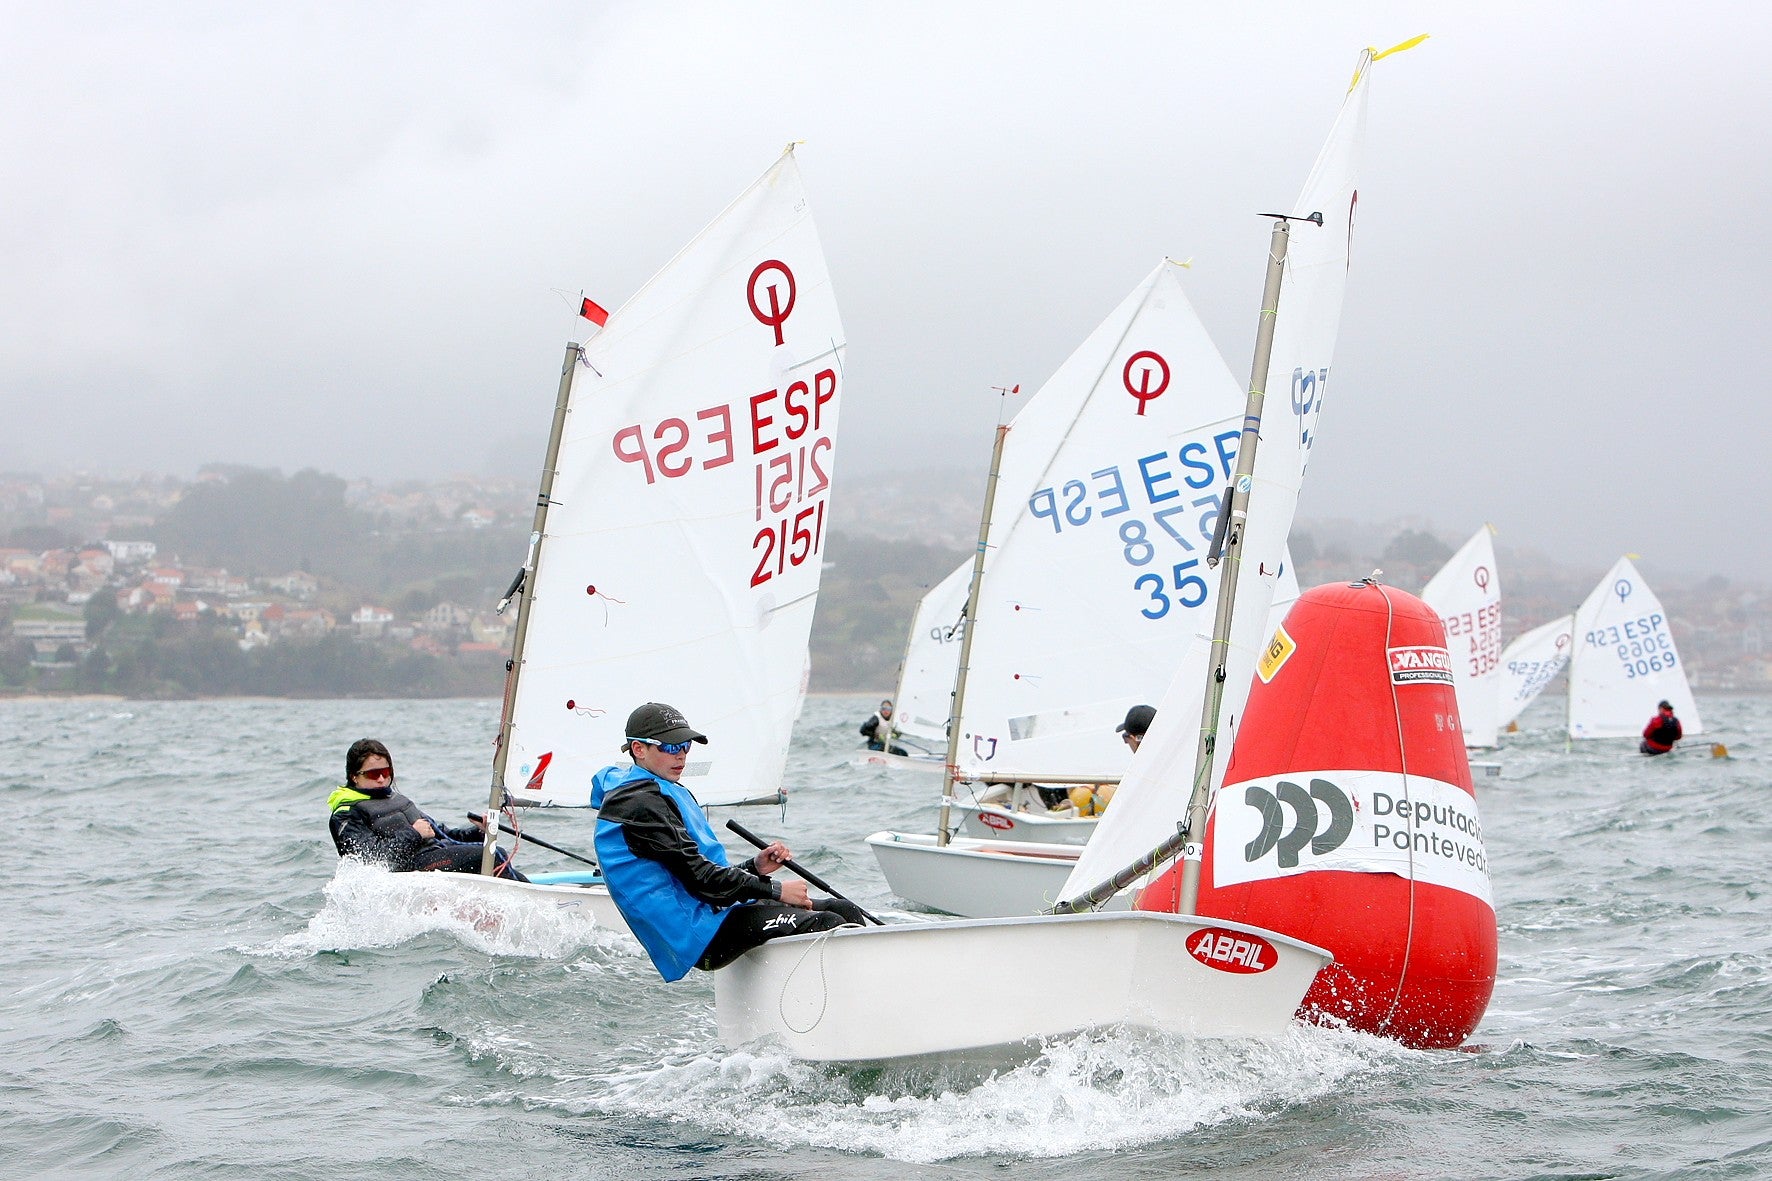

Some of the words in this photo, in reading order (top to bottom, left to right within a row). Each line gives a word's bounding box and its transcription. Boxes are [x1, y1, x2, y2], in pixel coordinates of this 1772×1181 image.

[750, 368, 836, 455] ESP
[750, 500, 824, 589] 2151
[1624, 614, 1662, 639] ESP
[1624, 651, 1675, 678] 3069
[1374, 824, 1491, 881] Pontevedr
[1193, 933, 1265, 970] ABRIL
